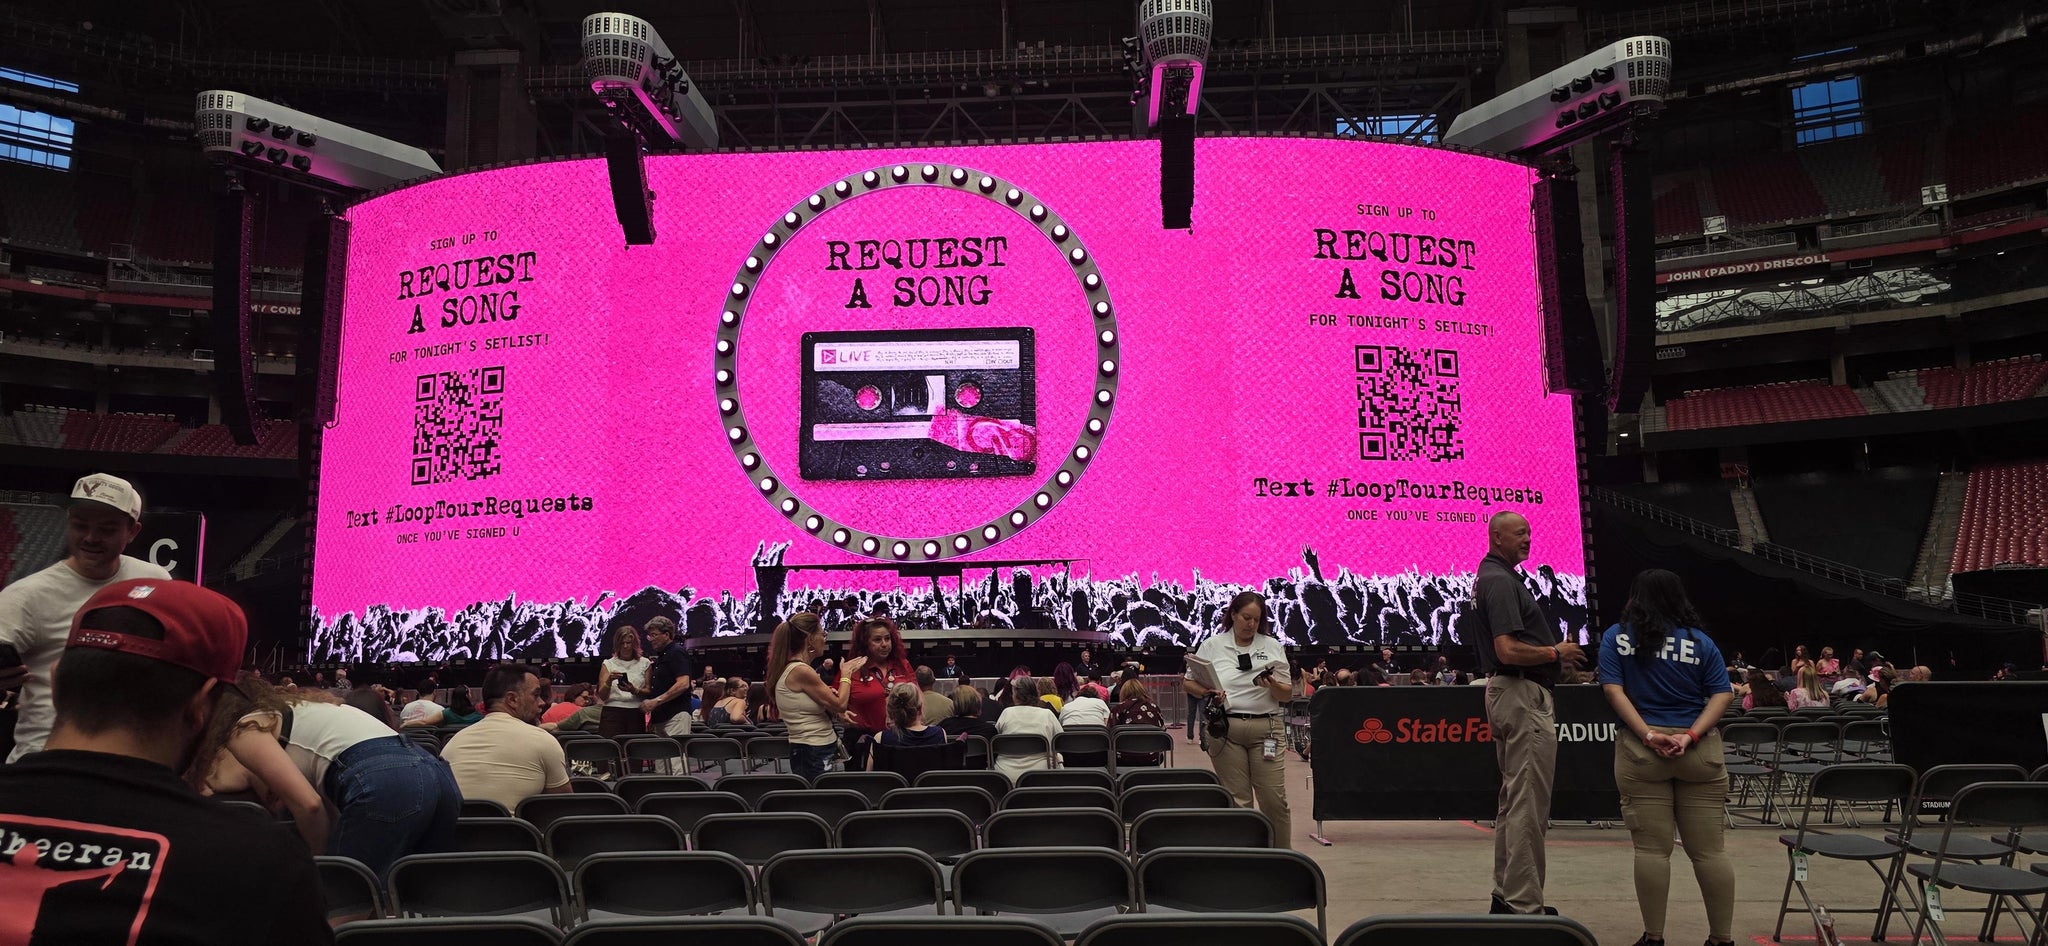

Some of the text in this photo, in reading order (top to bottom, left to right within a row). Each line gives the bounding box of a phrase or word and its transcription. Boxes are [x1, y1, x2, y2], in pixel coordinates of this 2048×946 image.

[1357, 203, 1436, 221] SIGN UP TO
[430, 230, 498, 251] SIGN UP TO
[825, 236, 1008, 271] REQUEST
[1312, 228, 1476, 271] REQUEST
[397, 251, 537, 301] REQUEST
[1666, 254, 1831, 283] JOHN (PADDY) DRISCOLL
[844, 274, 994, 309] A SONG
[1334, 267, 1468, 307] A SONG
[406, 290, 522, 335] A SONG
[1309, 313, 1495, 337] FOR TONIGHT'S SETLIST!
[389, 333, 549, 364] FOR TONIGHT'S SETLIST!
[839, 350, 872, 363] LIVE
[1253, 477, 1544, 506] Text #LoopTourRequests
[346, 492, 594, 529] Text #LoopTourRequests
[1347, 509, 1378, 521] ONCE
[1436, 511, 1476, 523] SIGNED
[396, 533, 418, 544] ONCE
[466, 527, 506, 539] SIGNED
[149, 537, 179, 572] C
[1615, 633, 1700, 665] S..F.E.
[1396, 717, 1463, 744] State
[1465, 717, 1493, 744] Fa
[1922, 801, 1951, 809] STADIUM
